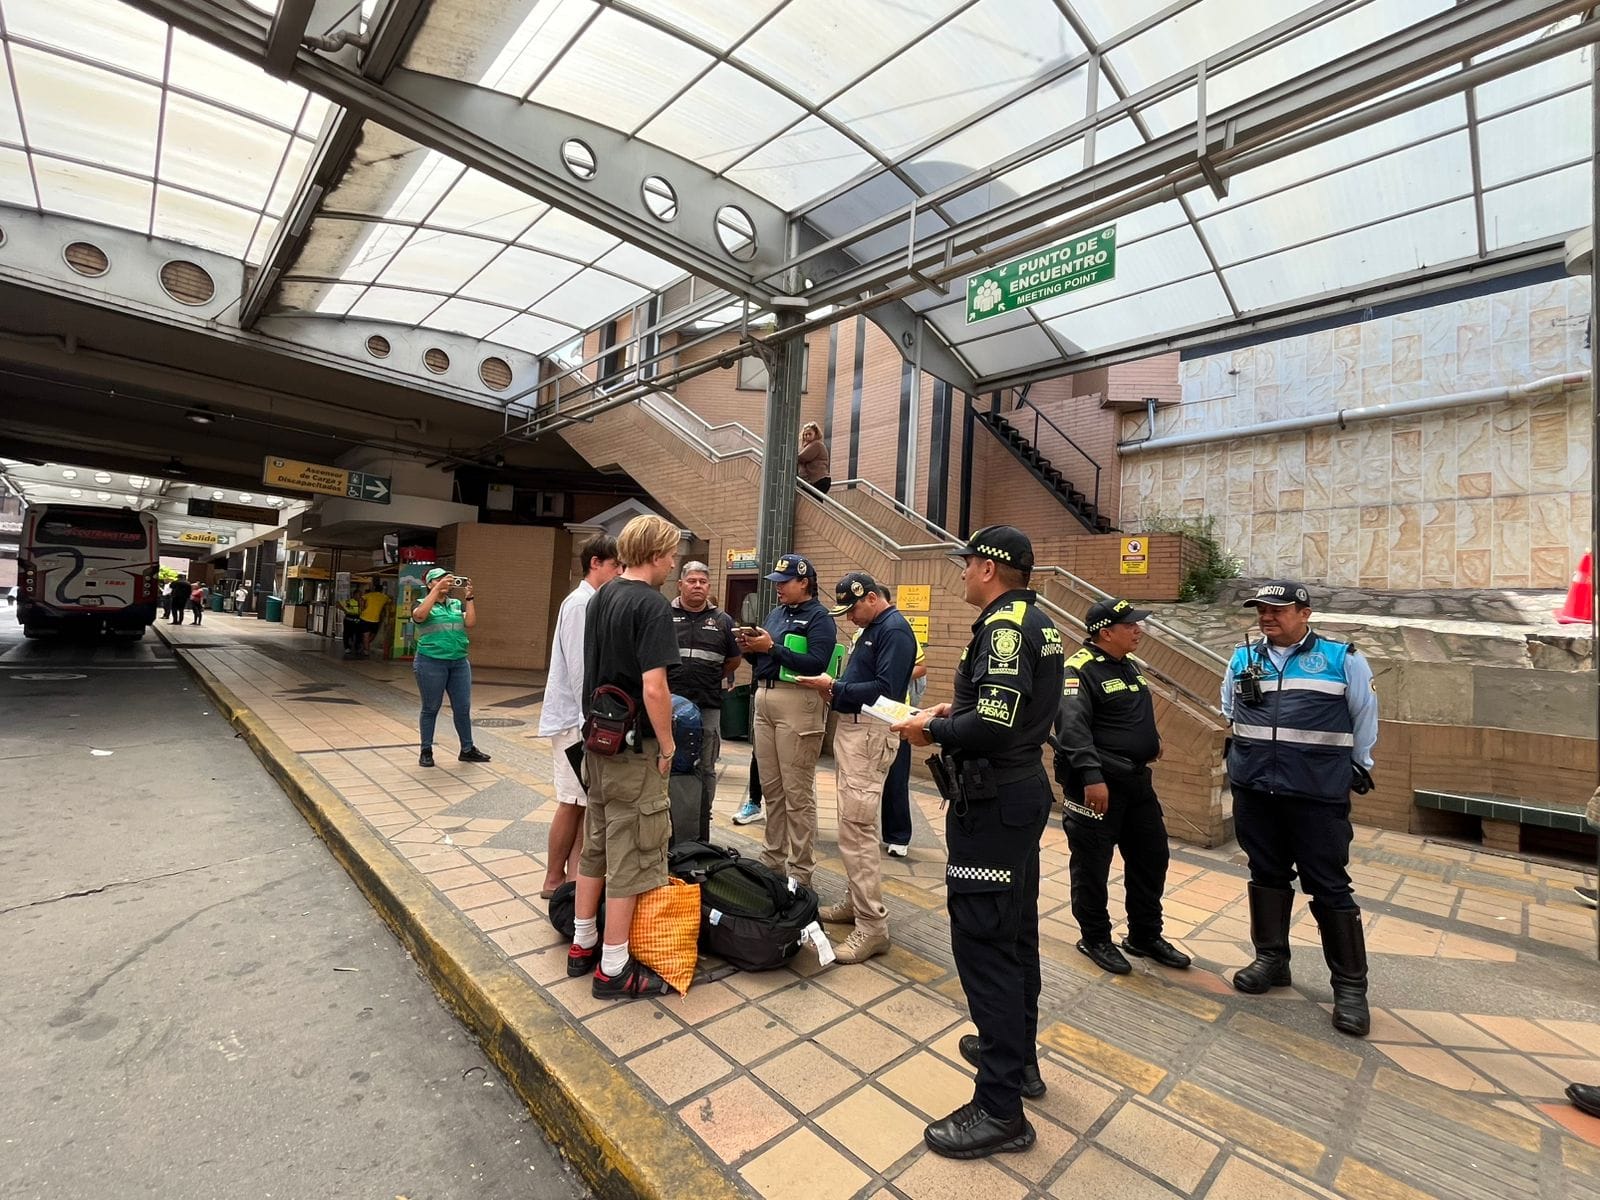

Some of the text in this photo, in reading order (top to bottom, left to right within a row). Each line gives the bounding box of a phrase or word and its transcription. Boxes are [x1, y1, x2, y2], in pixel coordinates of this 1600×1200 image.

[1018, 236, 1098, 275] PUNTO DE
[1010, 251, 1107, 293] ENCUENTRO
[1016, 271, 1098, 305] MEETING POINT
[305, 467, 343, 478] Ascensor
[312, 474, 336, 485] Carga
[278, 475, 341, 491] Discapacitados
[184, 533, 217, 542] Salida
[976, 705, 1010, 721] URISMO
